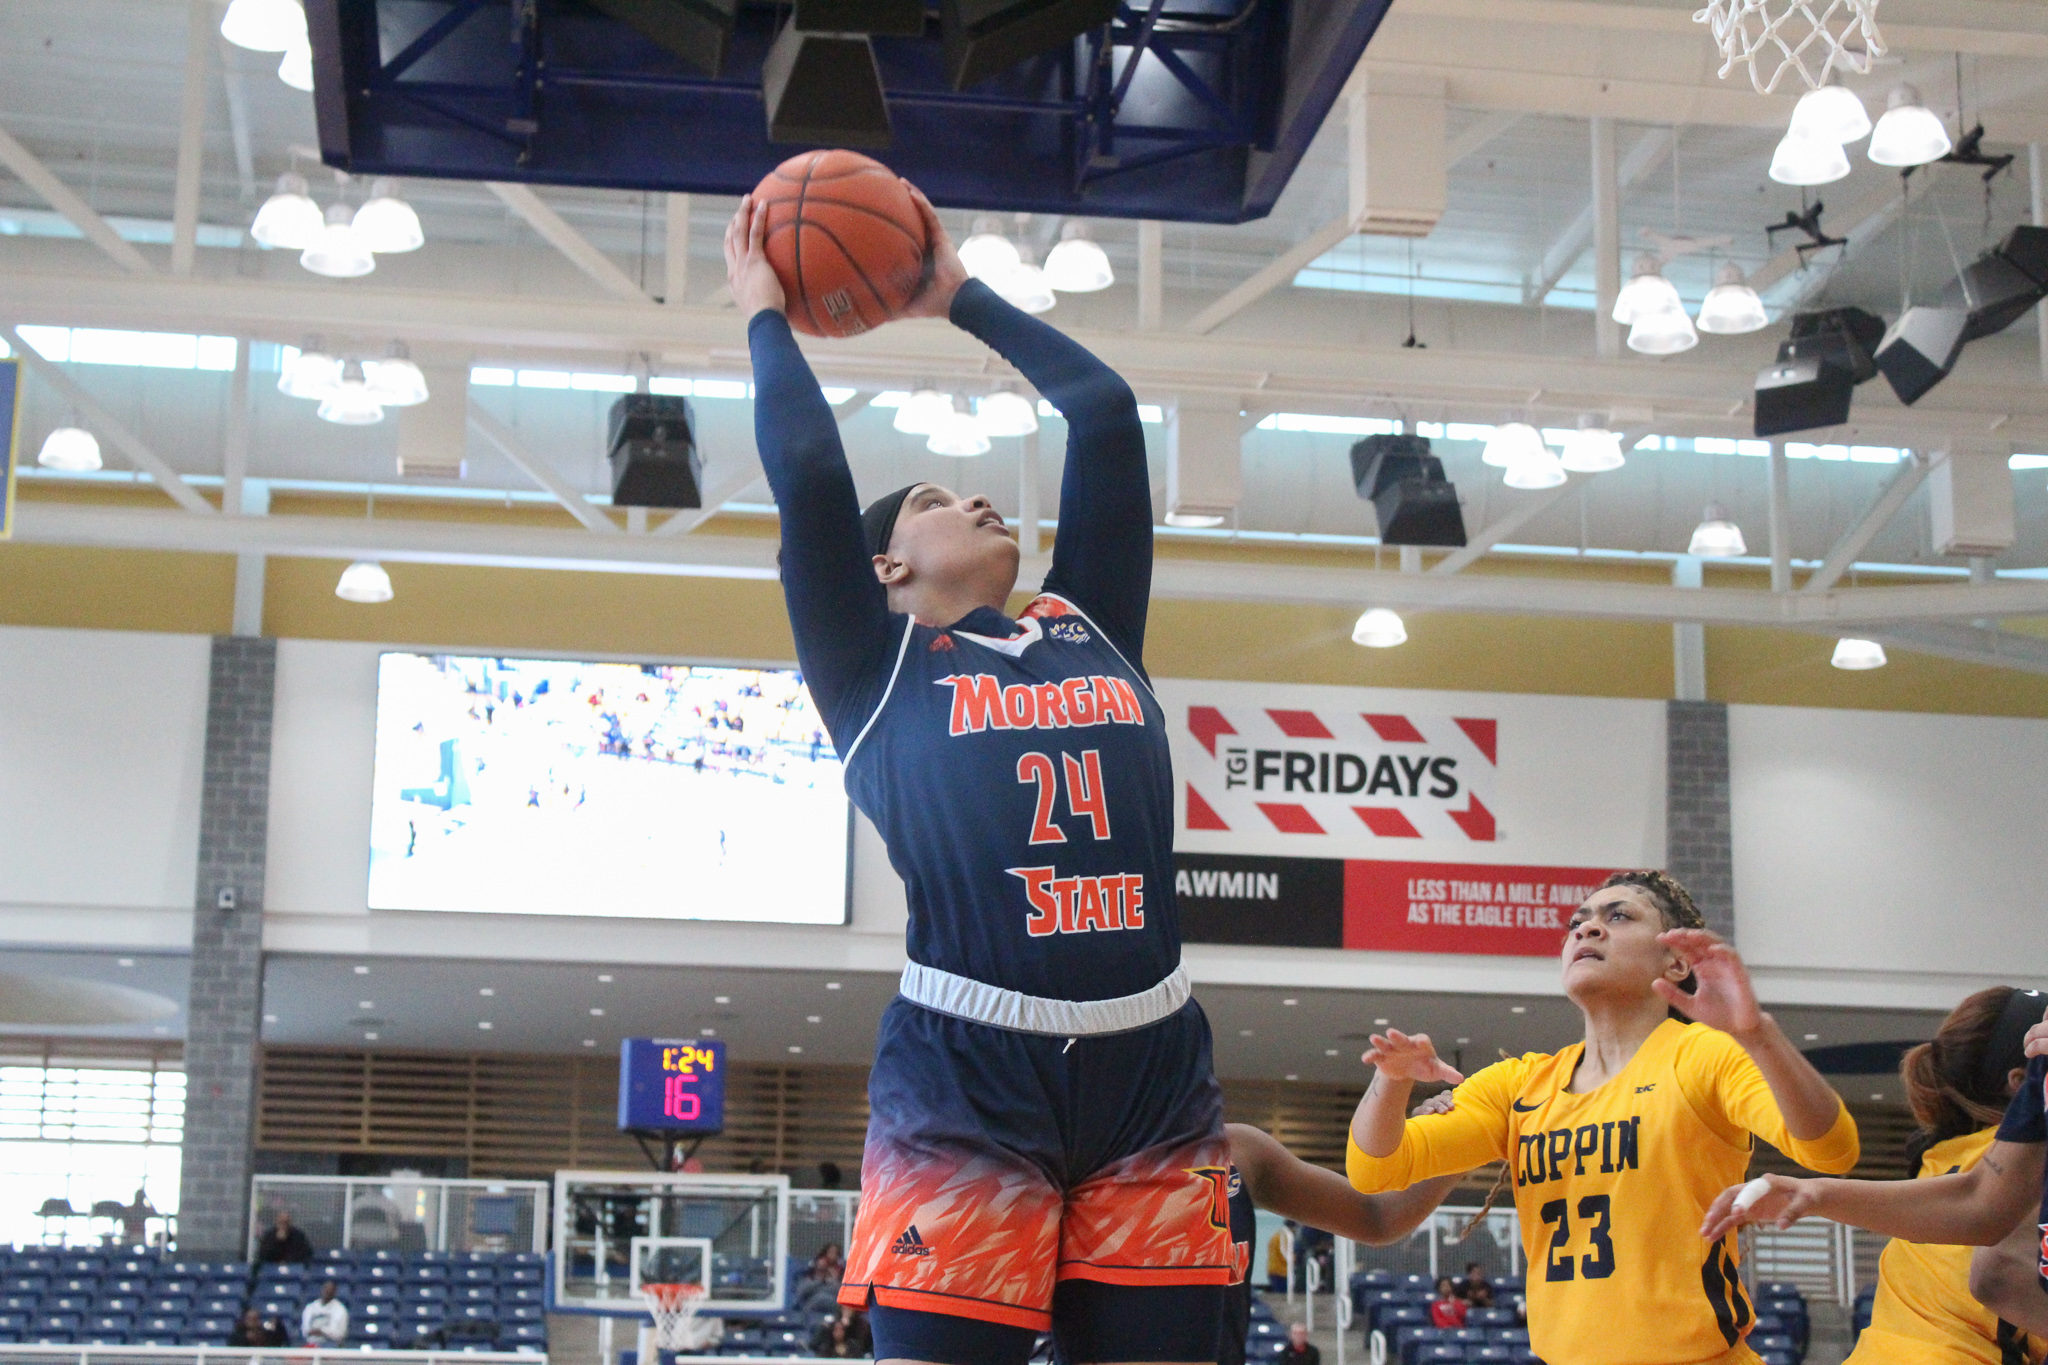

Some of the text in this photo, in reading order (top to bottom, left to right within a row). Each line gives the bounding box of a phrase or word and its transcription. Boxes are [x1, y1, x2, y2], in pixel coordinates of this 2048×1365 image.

[1226, 747, 1249, 790] TGI
[1253, 749, 1459, 799] FRIDAYS
[1016, 749, 1111, 845] 24
[1407, 878, 1448, 901] LESS
[1449, 880, 1492, 903] THAN
[1494, 882, 1507, 903] A
[1508, 883, 1547, 905] MILE
[1407, 902, 1430, 925] AS
[1431, 903, 1461, 926] THE
[1465, 905, 1513, 927] EAGLE
[663, 1046, 714, 1074] 1:24
[664, 1074, 701, 1120] 16
[1517, 1115, 1641, 1188] COPPIN
[891, 1244, 930, 1256] adidas
[1540, 1193, 1616, 1283] 23
